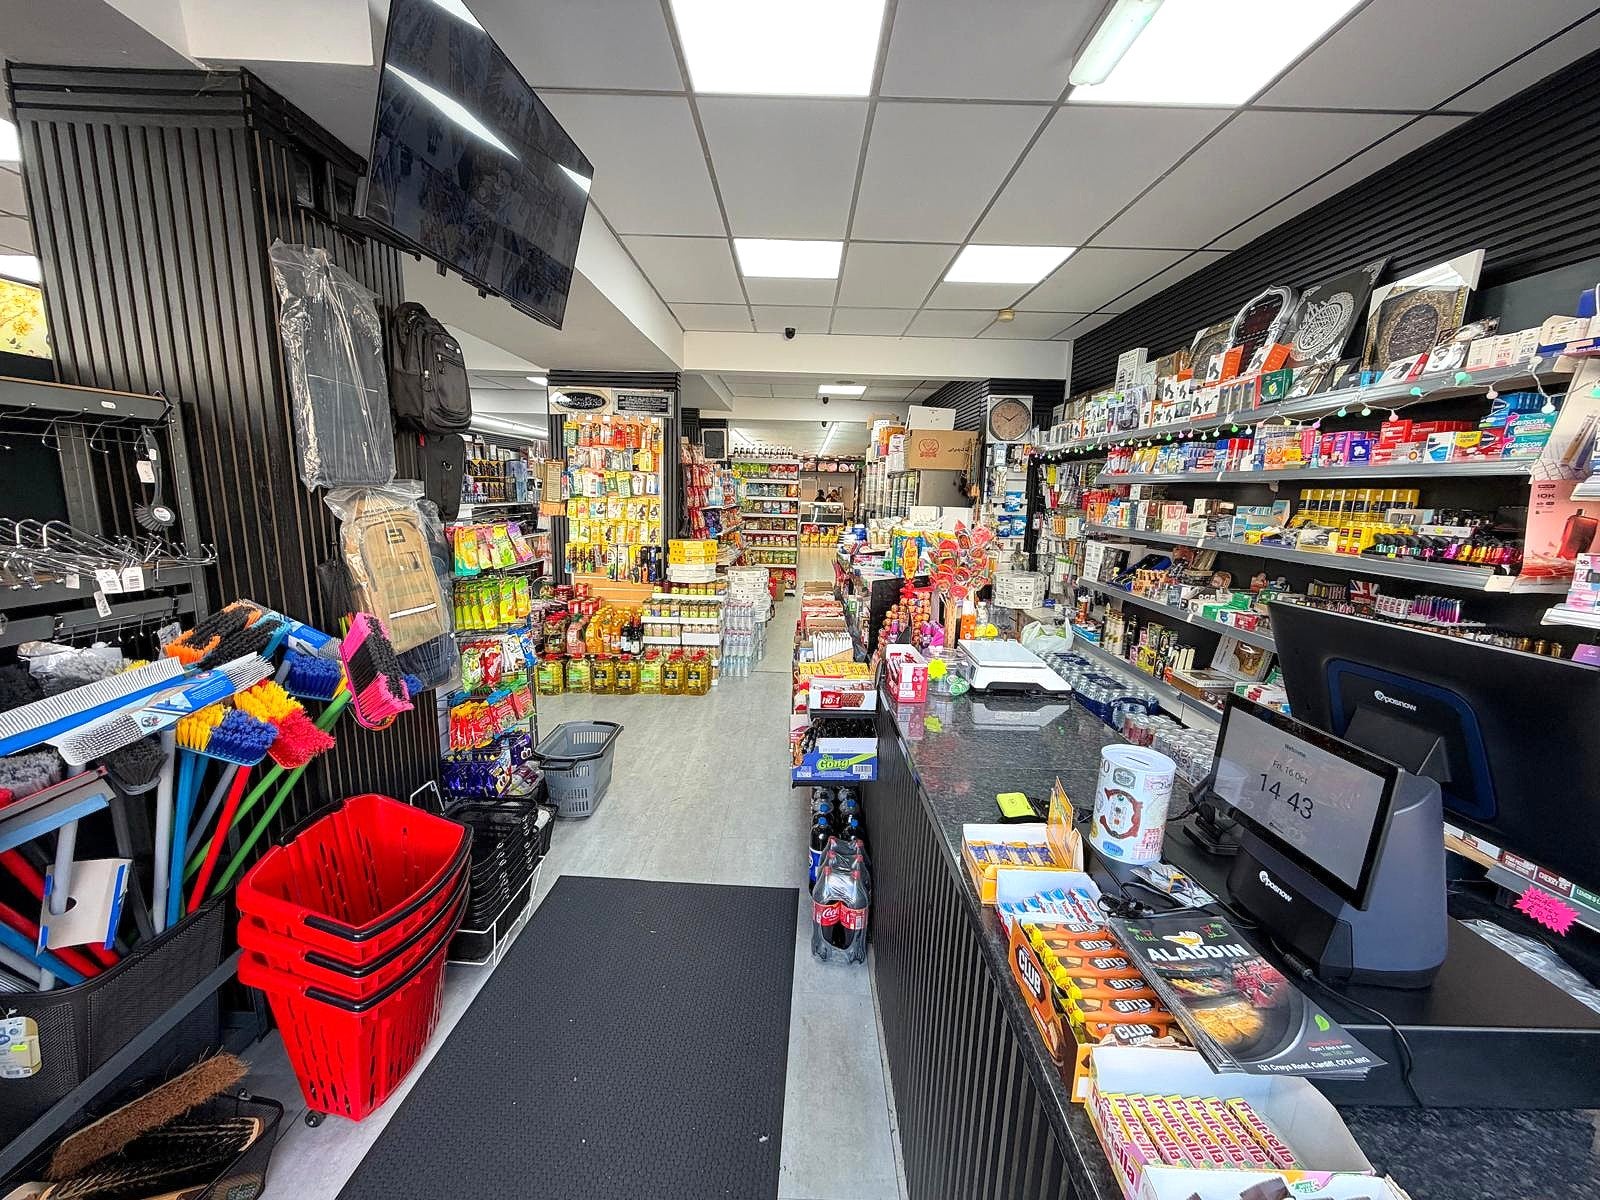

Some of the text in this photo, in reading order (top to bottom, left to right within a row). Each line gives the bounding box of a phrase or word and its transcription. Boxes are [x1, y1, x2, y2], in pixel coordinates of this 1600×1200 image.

[1018, 949, 1041, 995] CLUB
[1079, 939, 1113, 952] CLUB
[1094, 957, 1128, 970] CLUB
[1147, 943, 1251, 962] ALADDIN
[1109, 977, 1145, 990] CLUB
[1115, 999, 1153, 1013] CLUB
[1115, 1023, 1155, 1039] CLUB
[1115, 1098, 1157, 1160] Fruit-tella
[1133, 1098, 1182, 1160] Fruit-tella
[1153, 1099, 1204, 1161] Fruit-tella
[1172, 1100, 1225, 1163] Fruit-tella
[1191, 1100, 1245, 1163] Fruit-tella
[1209, 1100, 1266, 1164] Fruit-tella
[1236, 1101, 1296, 1163] Fruit-tella
